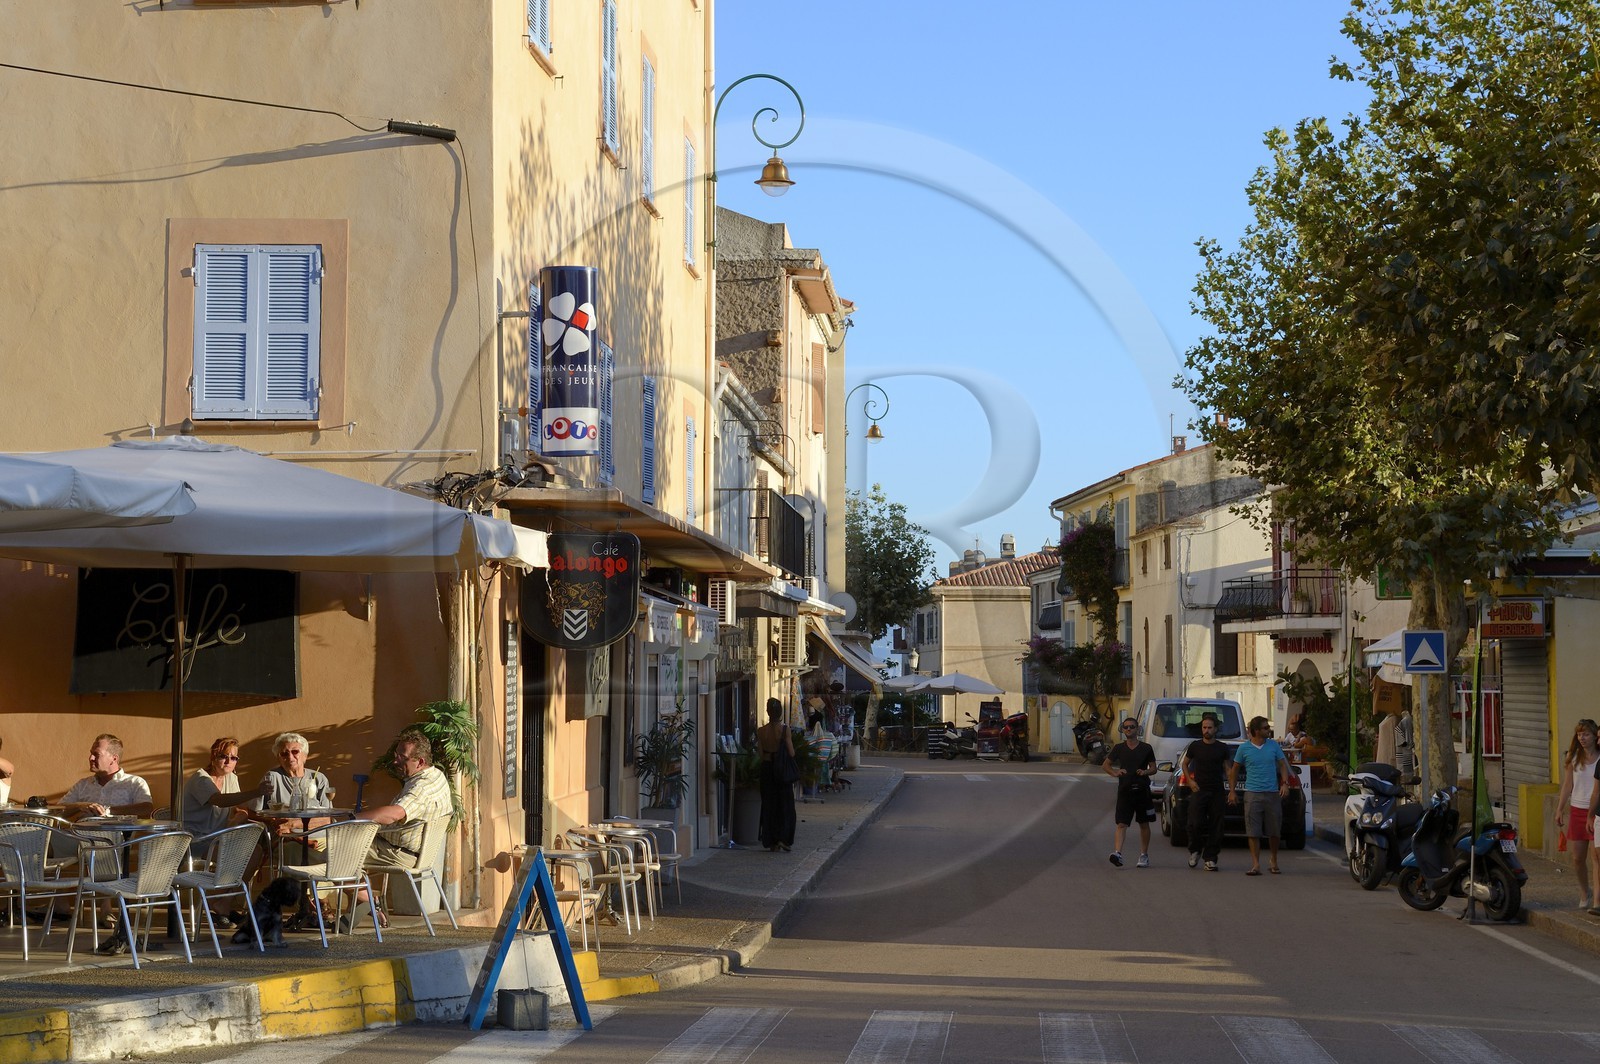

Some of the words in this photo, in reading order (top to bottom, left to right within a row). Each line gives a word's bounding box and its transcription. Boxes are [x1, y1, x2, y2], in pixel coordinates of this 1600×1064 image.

[543, 363, 597, 375] FRANÇAISE
[545, 377, 562, 385] DES
[568, 377, 595, 386] JEUX
[544, 417, 597, 440] LOTO
[591, 541, 619, 556] Café
[545, 549, 628, 579] alongo
[1487, 602, 1533, 621] PHOTO
